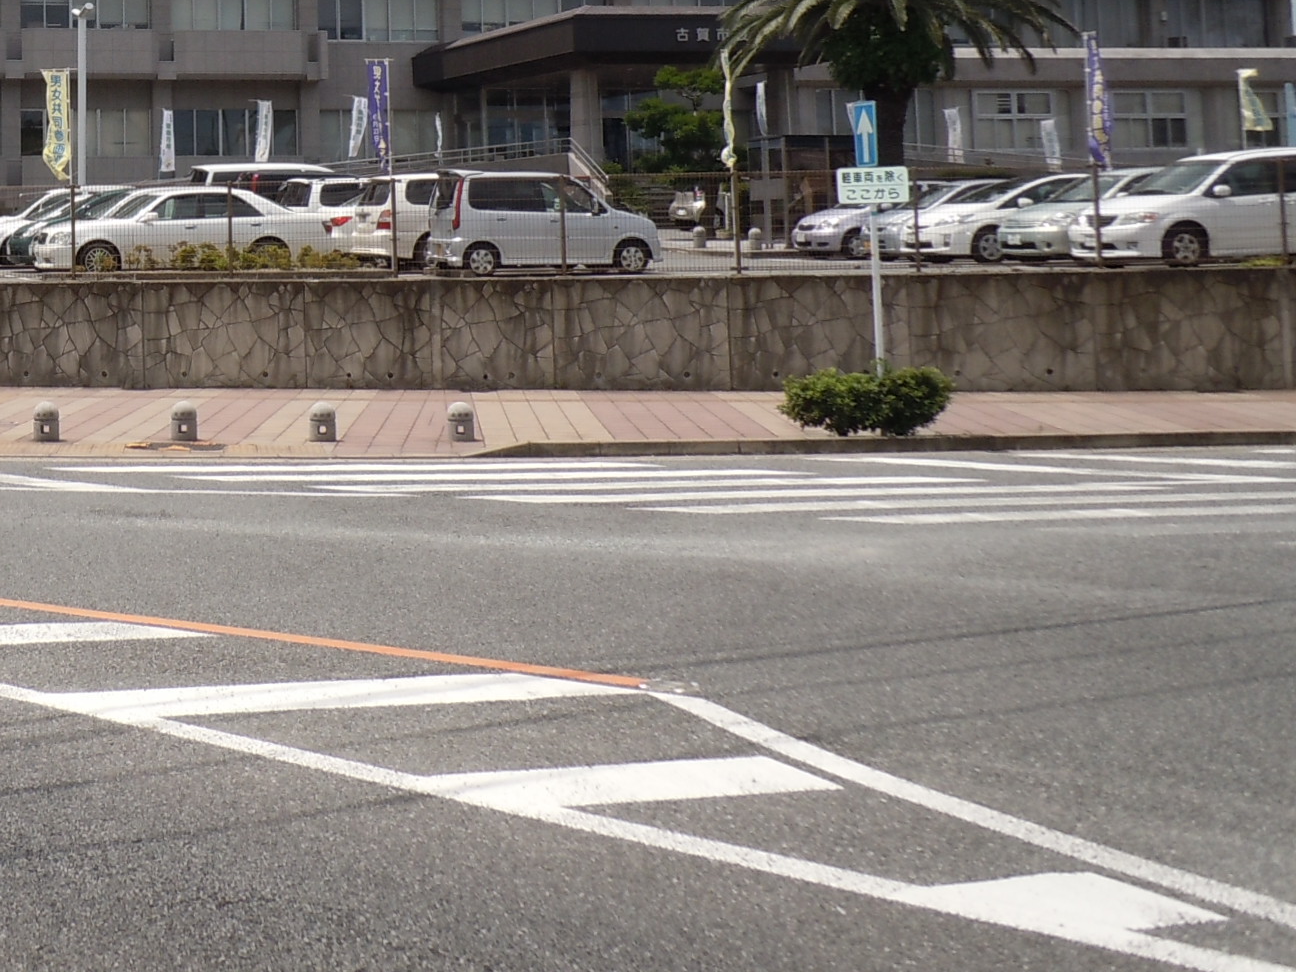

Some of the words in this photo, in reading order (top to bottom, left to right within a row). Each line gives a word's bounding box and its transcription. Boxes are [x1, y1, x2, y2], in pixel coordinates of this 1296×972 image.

[676, 27, 748, 42] 古賀市
[842, 170, 904, 184] 軽車両を除く
[846, 188, 900, 200] ここから
